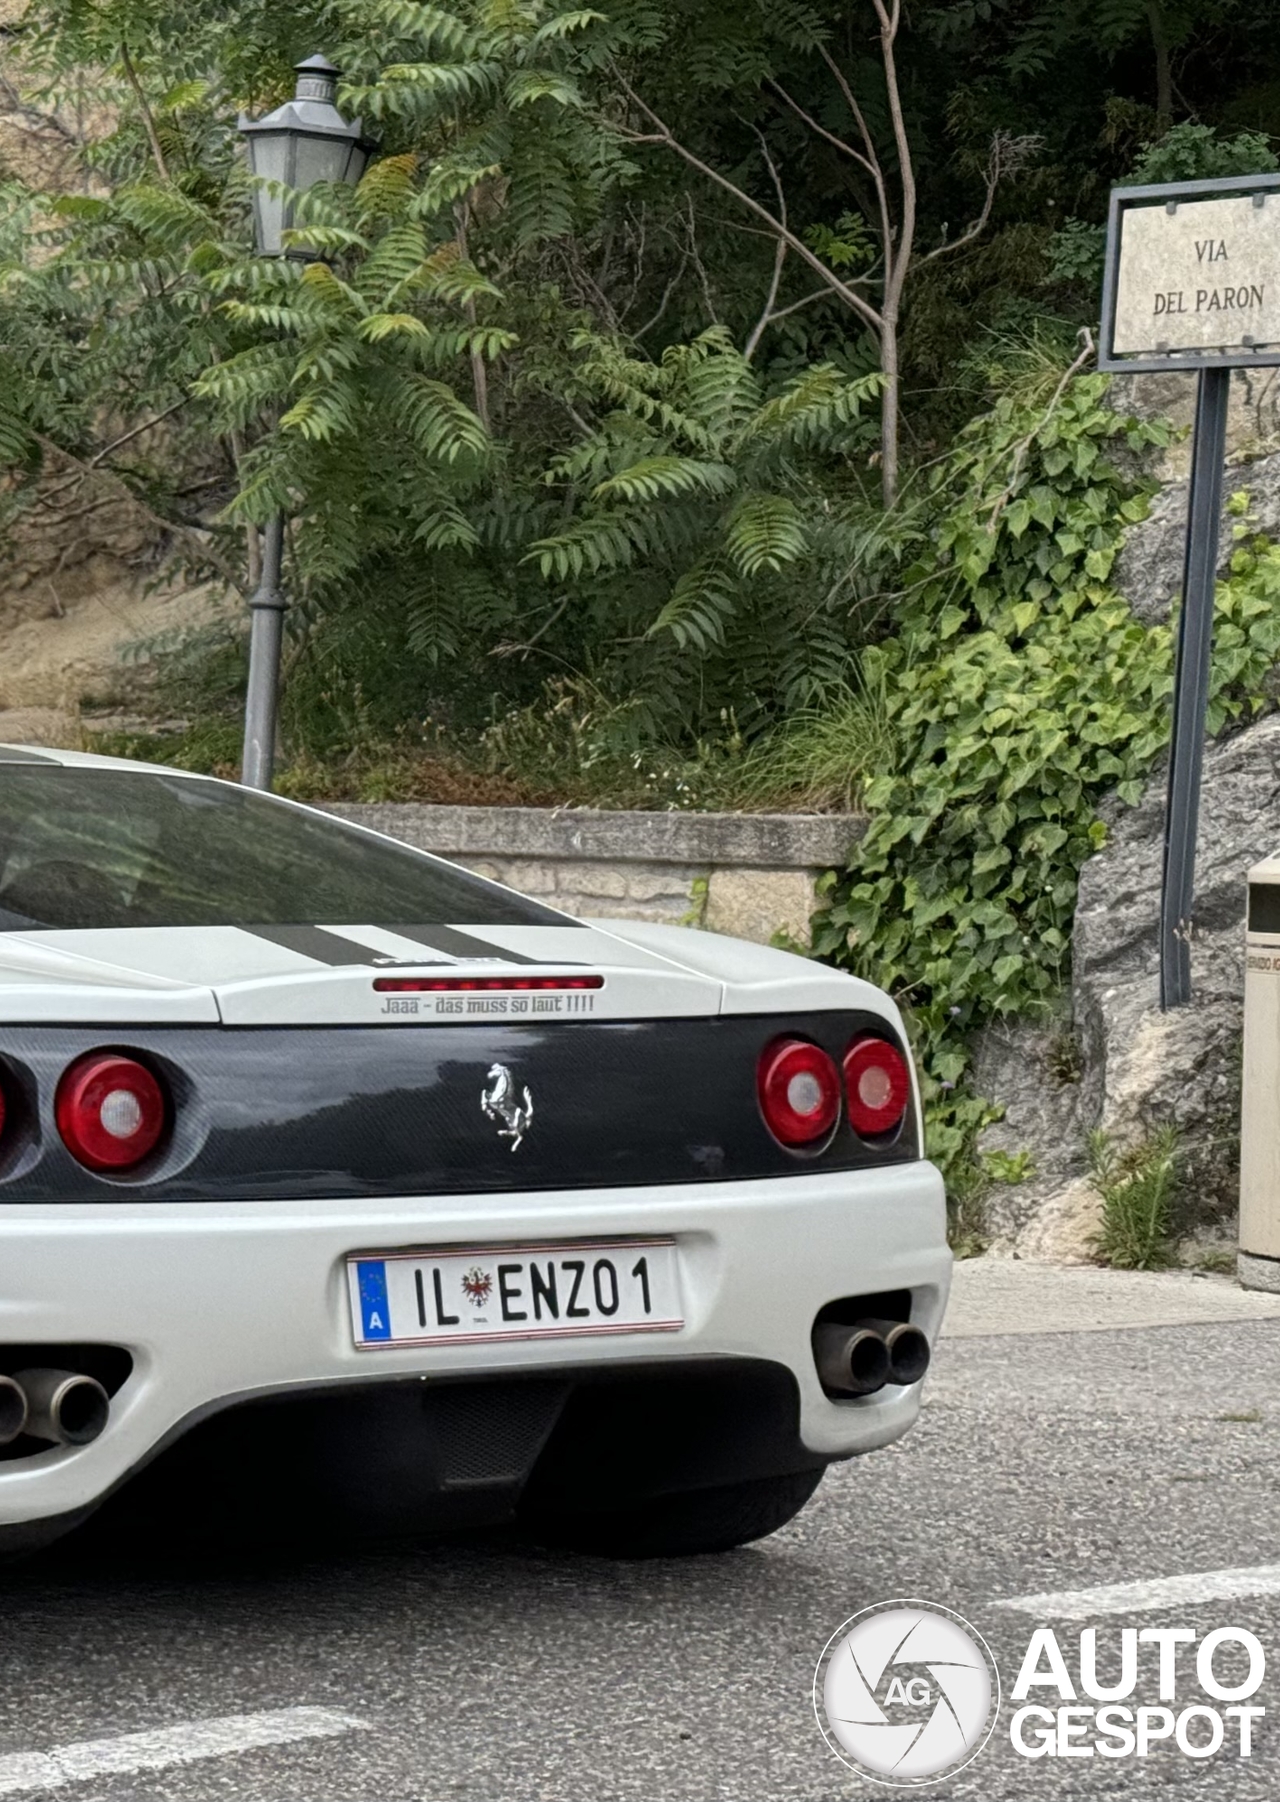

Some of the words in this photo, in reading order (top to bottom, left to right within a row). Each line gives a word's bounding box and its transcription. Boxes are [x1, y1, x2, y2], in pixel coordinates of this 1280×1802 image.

[1194, 239, 1228, 262] VIA
[1153, 291, 1188, 315] DEL
[1195, 284, 1265, 312] PARON
[381, 997, 421, 1014] Jaaa
[435, 996, 465, 1014] das
[467, 996, 509, 1013] muss
[510, 996, 530, 1012] so
[531, 995, 563, 1012] laut
[415, 1267, 460, 1328] IL
[632, 1256, 652, 1314] 1
[369, 1311, 383, 1329] A
